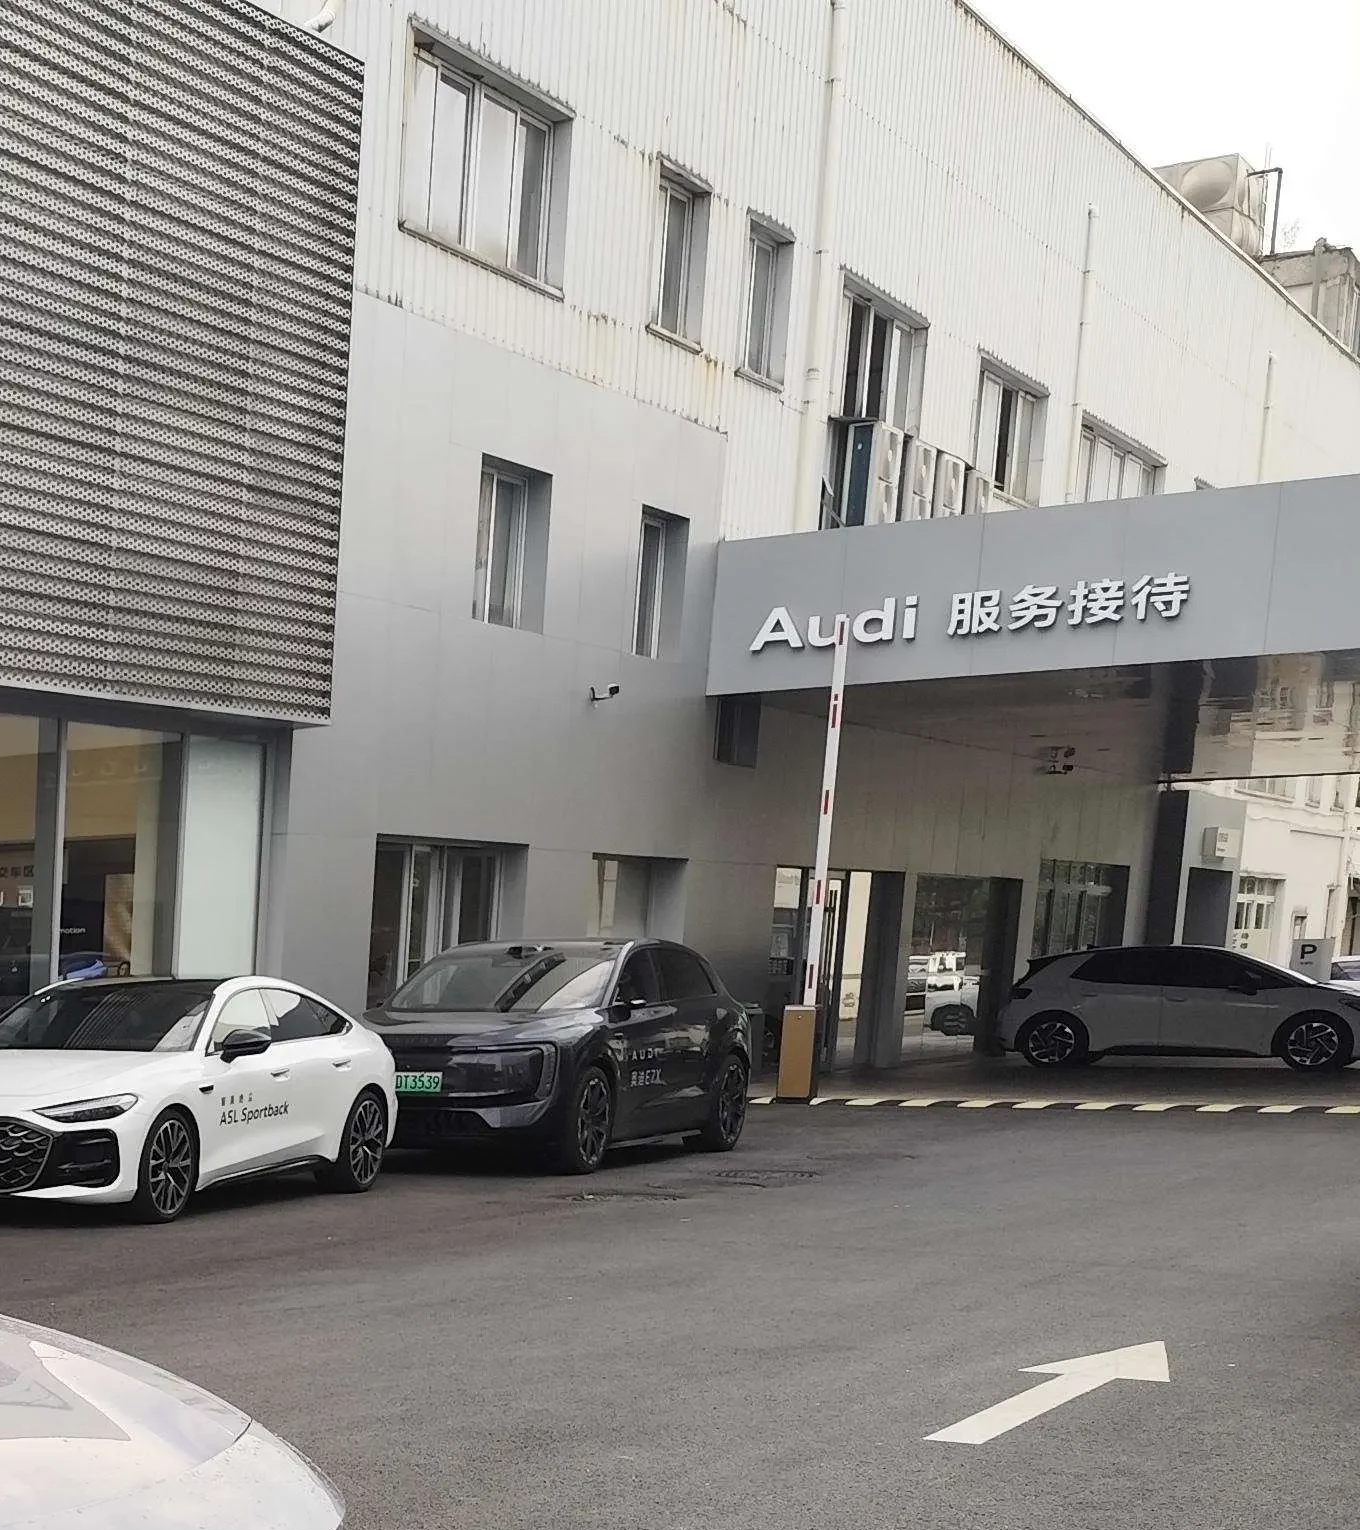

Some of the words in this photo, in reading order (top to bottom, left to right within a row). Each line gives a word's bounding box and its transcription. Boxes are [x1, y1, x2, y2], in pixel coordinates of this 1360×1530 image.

[749, 596, 918, 651] Audi
[947, 572, 1189, 637] 服务接待
[1300, 944, 1318, 960] P
[241, 1101, 289, 1124] Sportback
